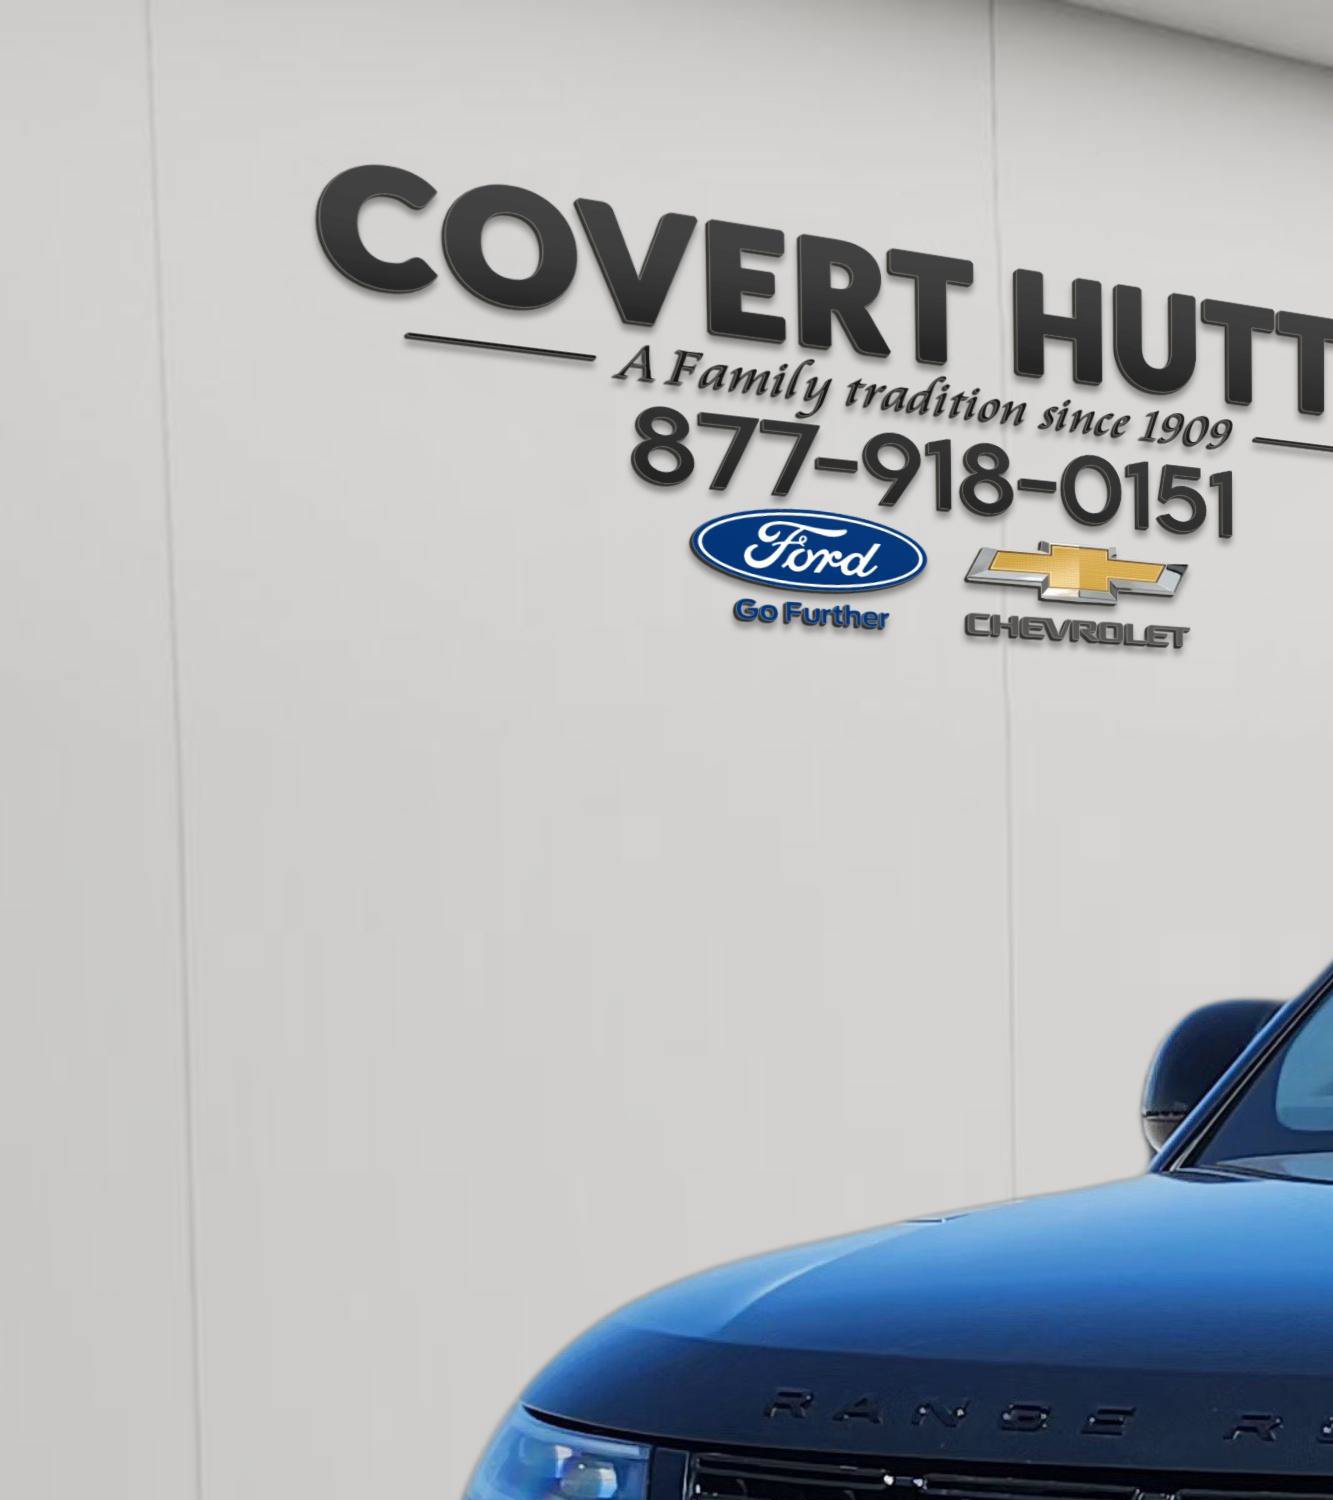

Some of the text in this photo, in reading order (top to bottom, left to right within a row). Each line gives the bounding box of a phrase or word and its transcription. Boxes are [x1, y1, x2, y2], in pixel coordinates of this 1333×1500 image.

[315, 164, 974, 367] COVERT
[612, 344, 1234, 451] A Family tradition since 1909
[630, 406, 1234, 540] 877-918-0151
[743, 521, 882, 579] Ford
[732, 598, 890, 631] Go Further
[964, 612, 1191, 650] CHEVROLET
[764, 1386, 1137, 1436] RANGE
